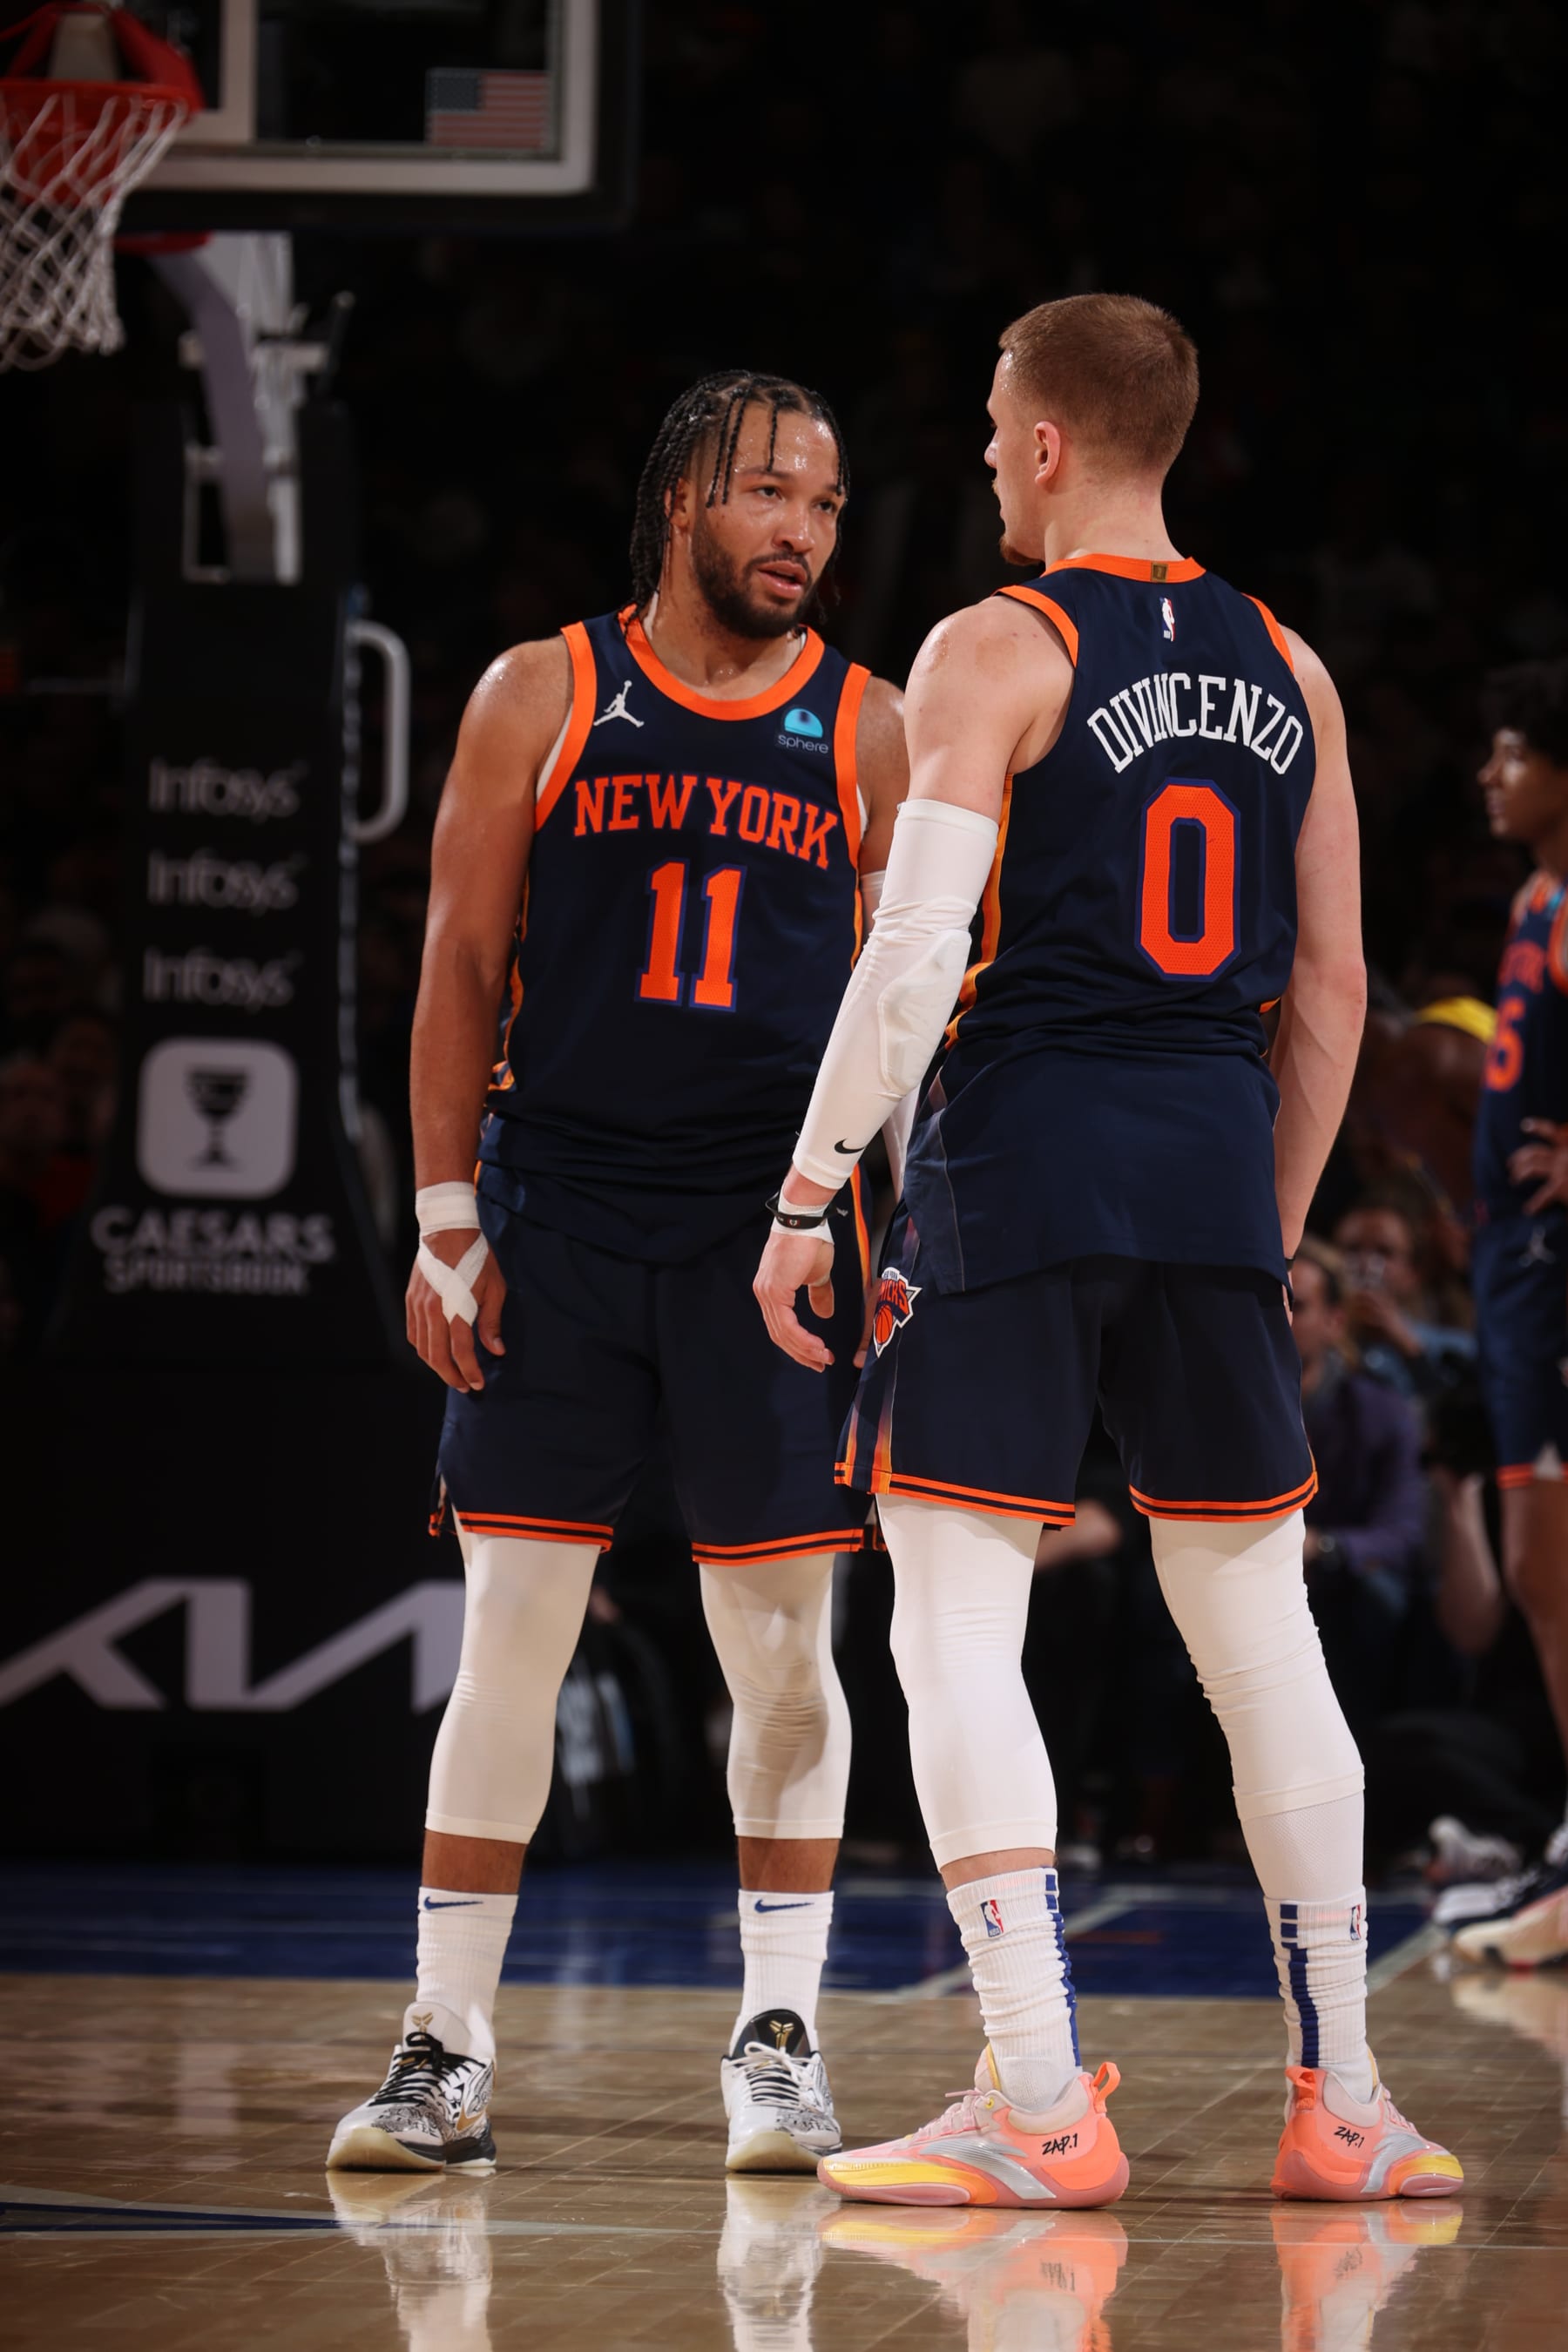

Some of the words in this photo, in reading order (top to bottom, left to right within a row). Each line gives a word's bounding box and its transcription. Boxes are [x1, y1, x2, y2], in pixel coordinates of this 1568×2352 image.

[777, 734, 829, 754] sphere
[1086, 672, 1304, 774] DIVINCENZO
[148, 756, 301, 825] Infosys
[573, 773, 698, 837] NEW
[705, 774, 839, 870] YORK
[147, 847, 300, 918] Infosys
[1134, 777, 1241, 982] 0
[633, 857, 747, 1012] 11
[142, 944, 296, 1015] Infosys
[90, 1206, 335, 1265] CAESARS
[1042, 2132, 1078, 2156] ZAP.1
